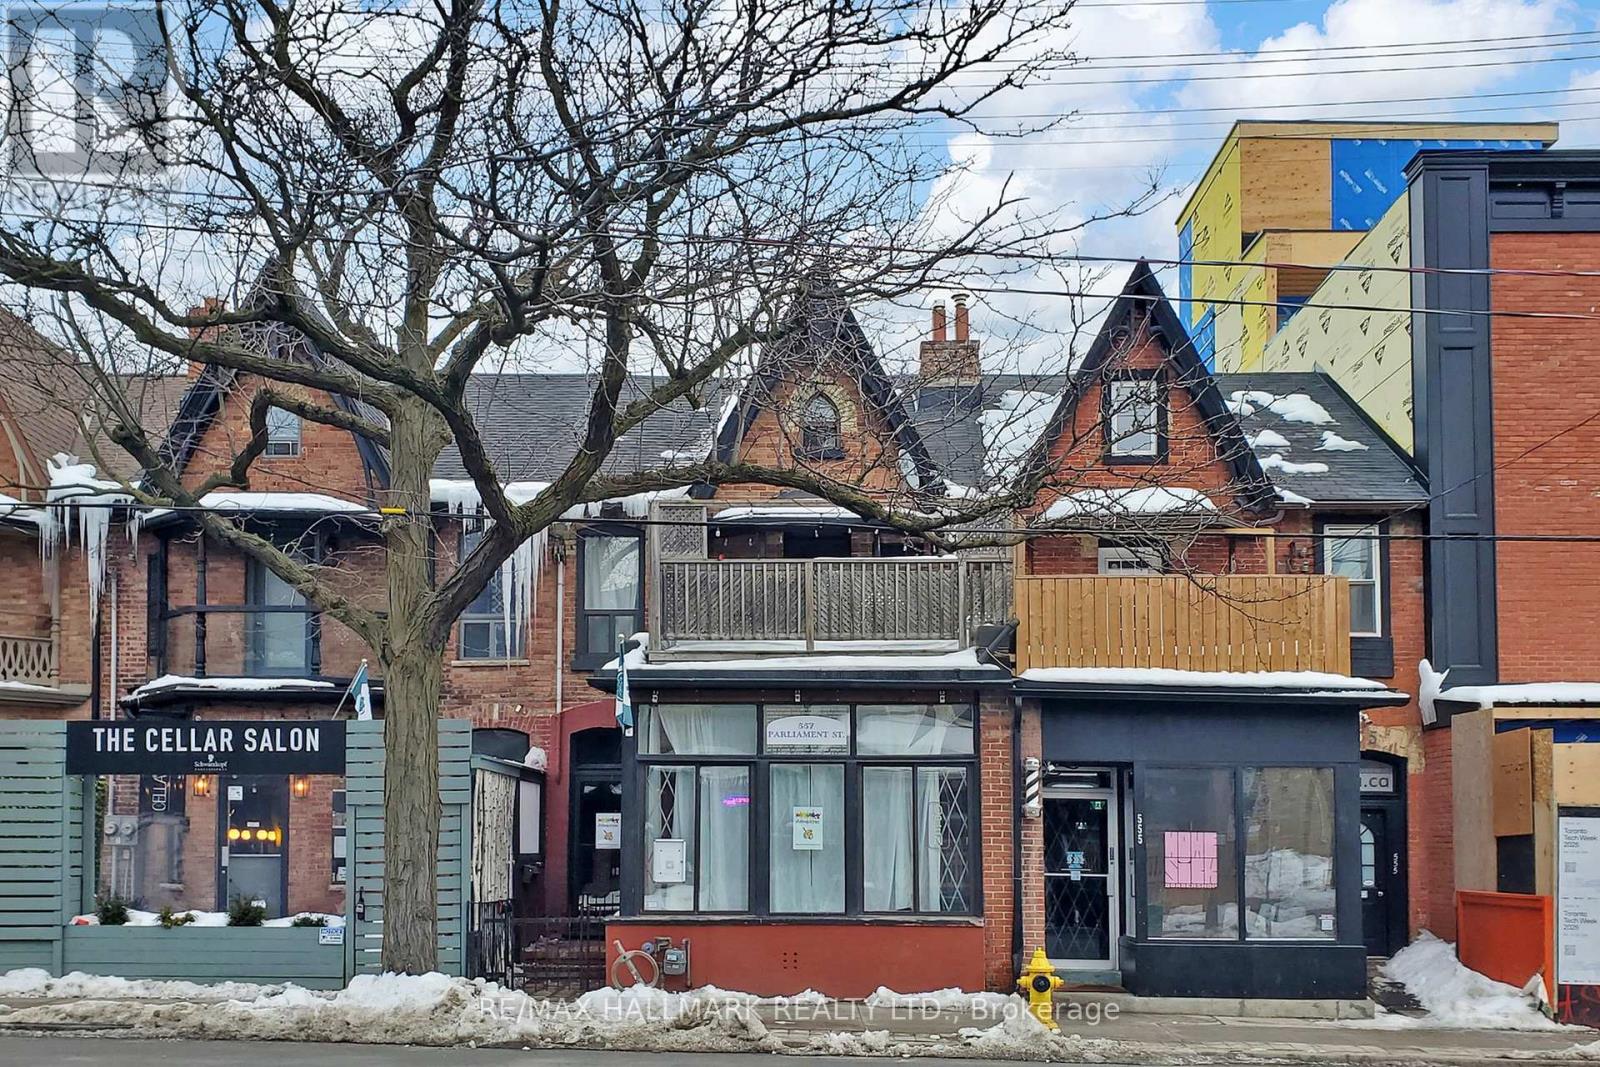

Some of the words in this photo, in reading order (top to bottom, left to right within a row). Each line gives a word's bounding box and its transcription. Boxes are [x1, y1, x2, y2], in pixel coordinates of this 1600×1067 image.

[92, 727, 135, 752] THE
[145, 727, 234, 752] CELLAR
[243, 727, 320, 752] SALON
[768, 730, 829, 738] PARLIAMENT
[1360, 776, 1389, 788] .ca
